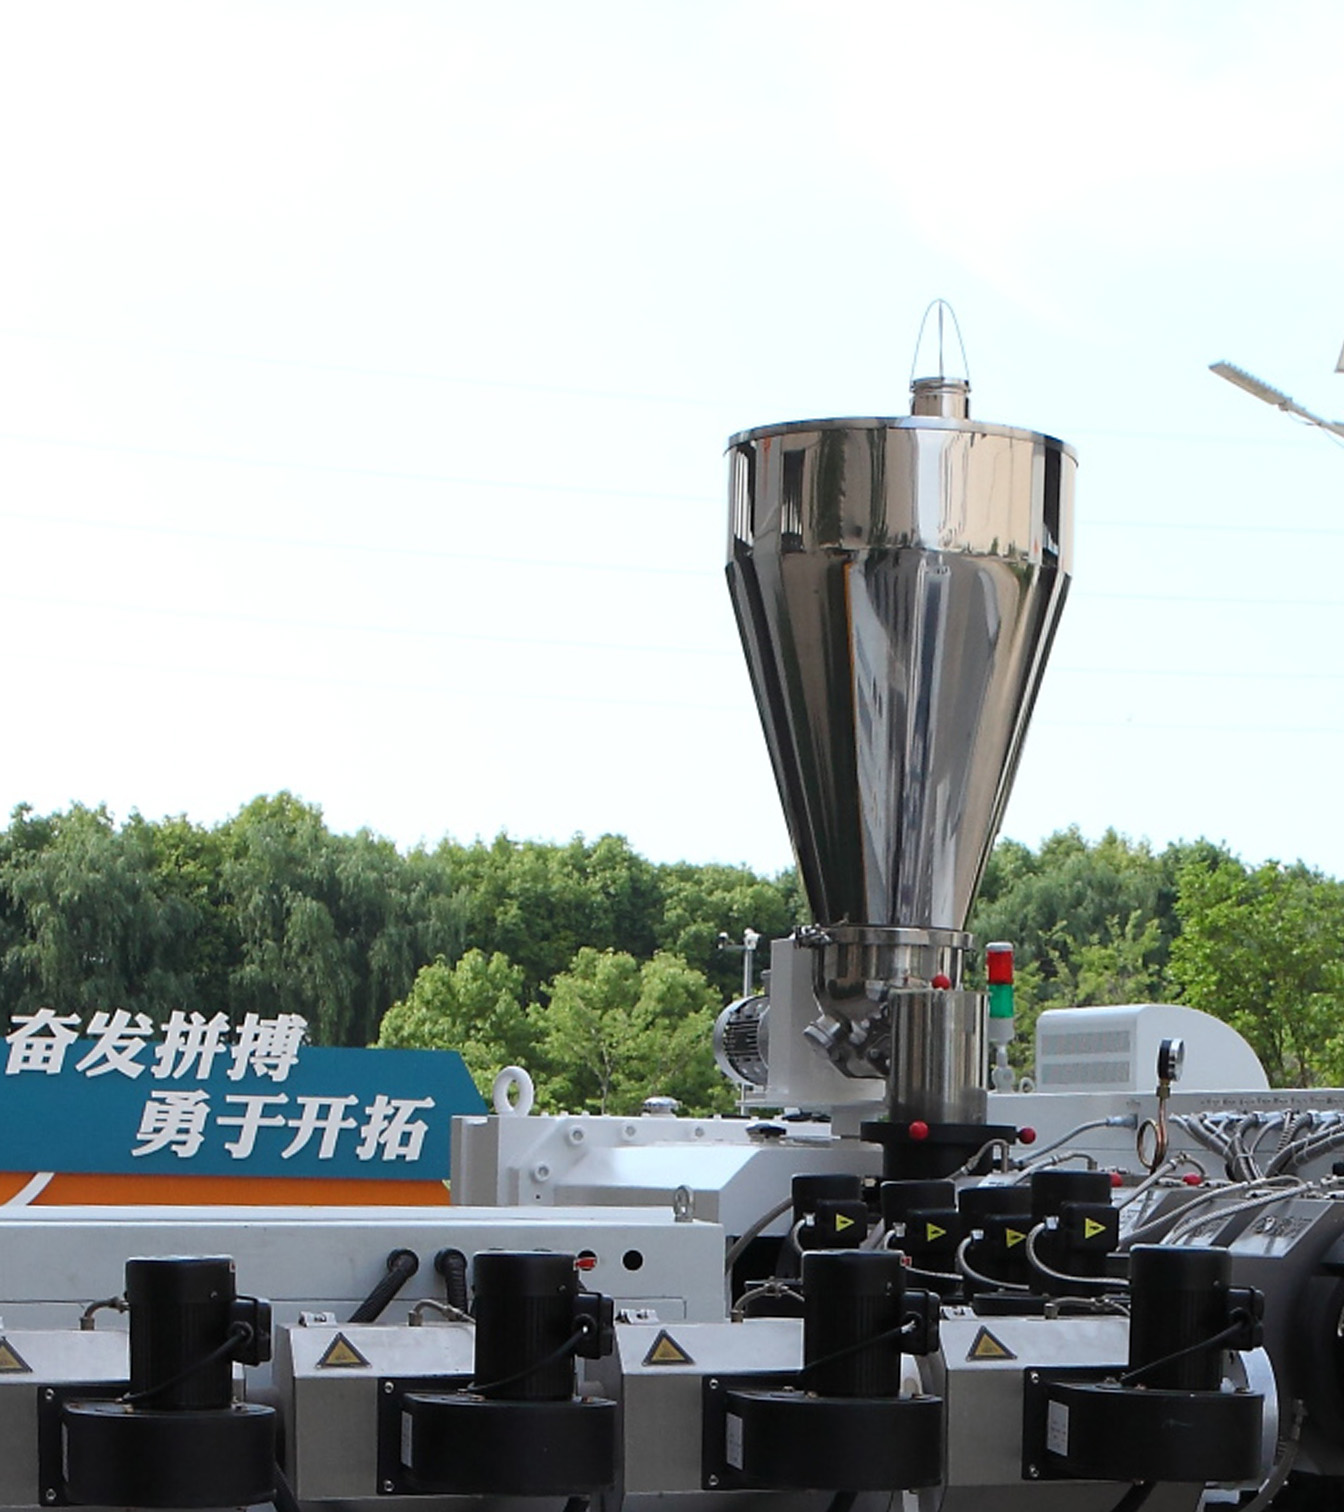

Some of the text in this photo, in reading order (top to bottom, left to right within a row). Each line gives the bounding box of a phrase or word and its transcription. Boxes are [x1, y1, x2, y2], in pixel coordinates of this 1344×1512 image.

[5, 1007, 309, 1082] 奋发拼搏
[131, 1089, 436, 1162] 勇于开拓
